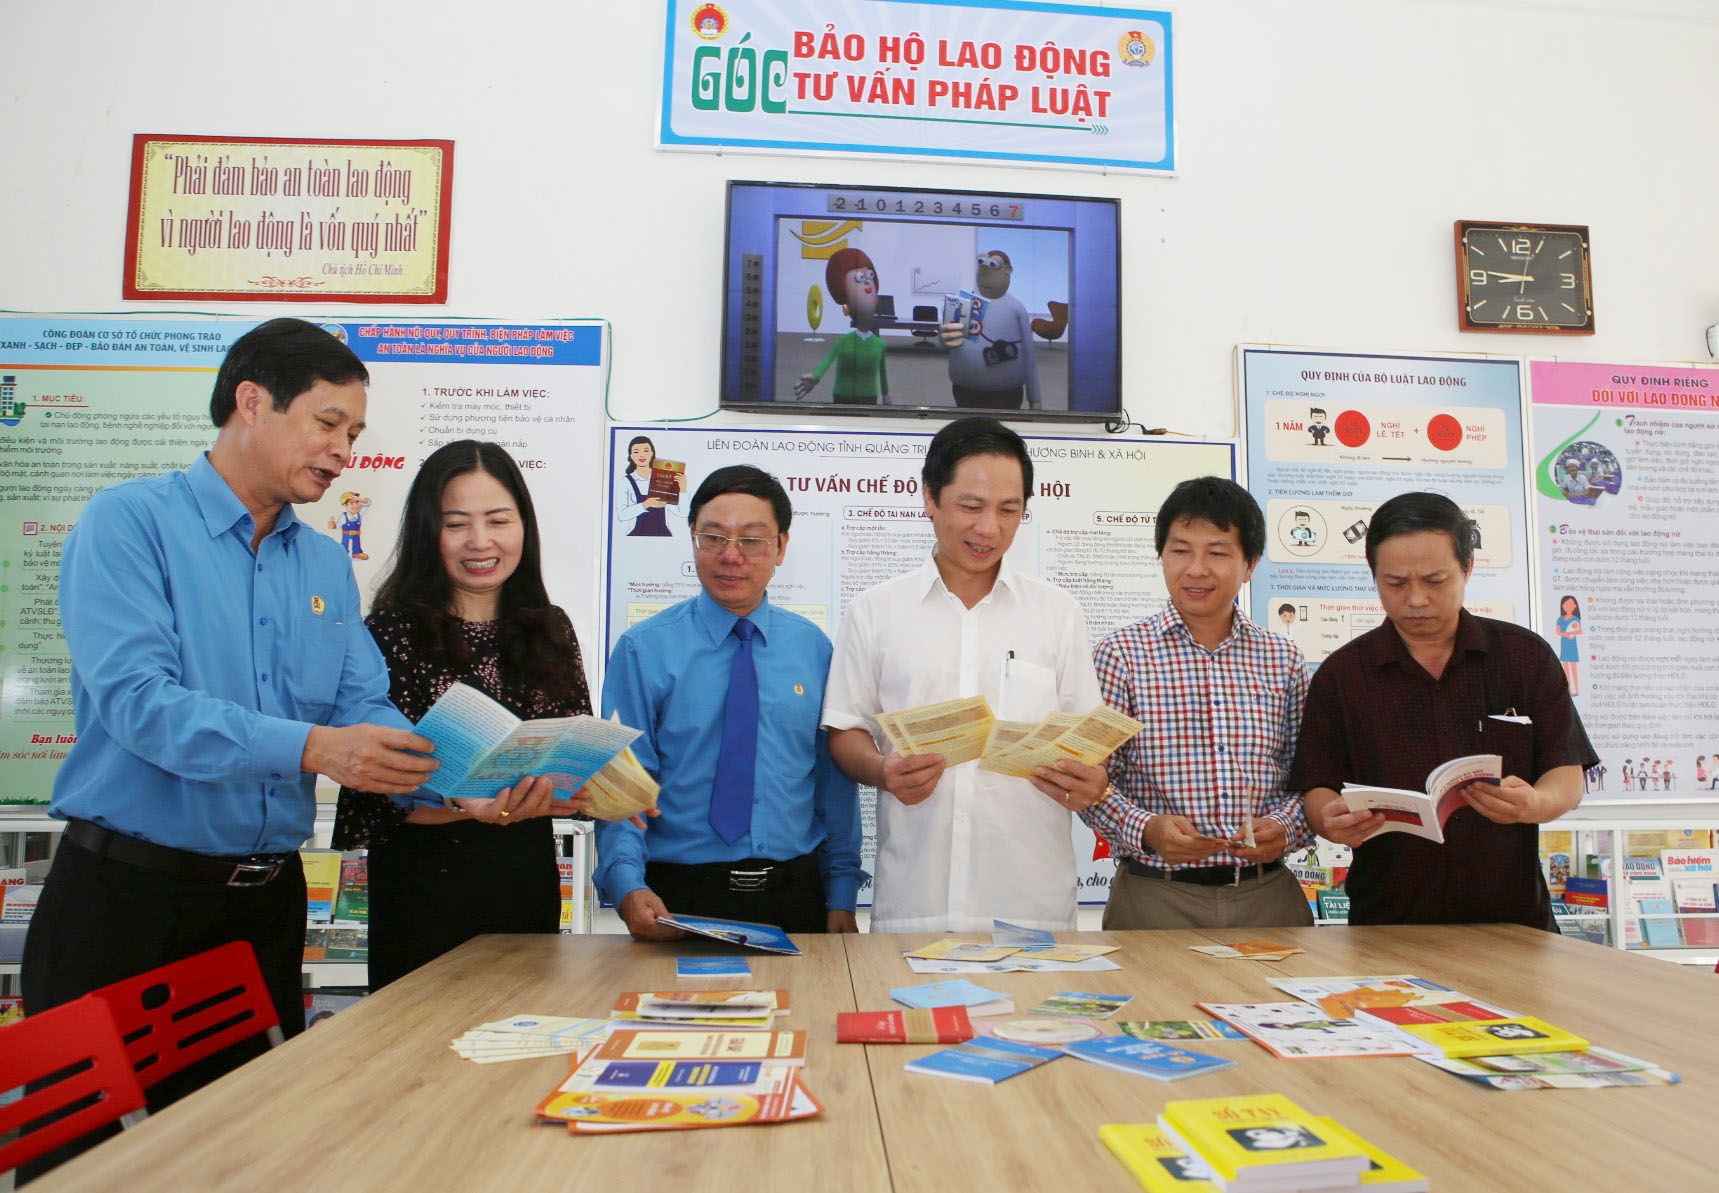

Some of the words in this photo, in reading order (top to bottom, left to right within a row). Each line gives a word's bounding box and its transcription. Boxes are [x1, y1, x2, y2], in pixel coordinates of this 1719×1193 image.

[793, 24, 864, 62] BẢO
[879, 33, 924, 71] HỘ
[939, 39, 1000, 70] LAO
[1014, 41, 1110, 78] ĐỘNG
[691, 32, 788, 115] GÓC
[793, 71, 838, 101] TƯ
[848, 65, 916, 105] VẤN
[929, 79, 1019, 111] PHÁP
[1031, 85, 1110, 123] LUẬT
[212, 155, 245, 196] đảm
[251, 156, 278, 196] bảo
[283, 166, 301, 196] an
[308, 159, 341, 197] toàn
[346, 160, 369, 198] lao
[374, 161, 411, 206] động
[877, 200, 886, 211] 0
[896, 200, 905, 212] 1
[914, 201, 924, 213] 2
[934, 203, 943, 214] 3
[952, 203, 961, 214] 4
[972, 204, 980, 216] 5
[990, 205, 1000, 216] 6
[1009, 206, 1018, 217] 7
[161, 209, 173, 248] vì
[178, 210, 223, 256] người
[228, 210, 250, 249] lao
[257, 211, 294, 257] động
[299, 210, 312, 250] là
[319, 207, 346, 251] vốn
[351, 213, 379, 259] quý
[1512, 239, 1531, 254] 12
[383, 265, 403, 276] Minh
[1470, 270, 1486, 285] 9
[1560, 273, 1575, 288] 3
[1517, 305, 1533, 320] 6
[43, 329, 67, 338] CÔNG
[359, 324, 381, 337] CHẤP
[383, 325, 406, 338] HÀNH
[408, 326, 423, 340] NỘI
[444, 328, 460, 340] QUY
[490, 327, 511, 342] BIỆN
[512, 328, 534, 340] PHÁP
[535, 328, 553, 340] LÀM
[555, 329, 574, 343] VIỆC
[377, 343, 390, 354] AN
[392, 341, 414, 354] TOÀN
[415, 342, 426, 354] LÀ
[427, 343, 453, 355] NGHĨA
[455, 344, 466, 357] VỤ
[486, 343, 513, 356] NGƯỜI
[513, 346, 529, 356] LAO
[1301, 370, 1321, 381] QUY
[1374, 372, 1387, 384] BỘ
[1418, 376, 1435, 385] LAO
[1439, 376, 1466, 388] ĐỘNG
[1612, 375, 1636, 385] QUY
[1675, 376, 1709, 388] RIÊNG
[434, 387, 472, 397] TRƯỚC
[476, 389, 493, 397] KHI
[497, 387, 519, 397] LÀM
[522, 390, 550, 399] VIỆC:
[1644, 393, 1666, 405] LAO
[1276, 422, 1280, 430] 1
[1284, 420, 1302, 431] NĂM
[707, 439, 729, 449] LIÊN
[733, 439, 768, 450] ĐOÀN
[772, 441, 795, 451] LAO
[798, 440, 835, 453] ĐỘNG
[839, 440, 861, 452] TỈNH
[865, 441, 909, 454] QUẢNG
[912, 445, 927, 456] TRỊ
[1029, 447, 1067, 459] HƯƠNG
[1070, 449, 1094, 459] BINH
[1098, 449, 1105, 458] &
[1109, 448, 1123, 459] XÃ
[1127, 448, 1146, 462] HỘI
[359, 454, 404, 472] ĐỘNG
[519, 460, 546, 470] VIỆC:
[787, 477, 811, 491] TƯ
[816, 474, 850, 492] VẤN
[857, 475, 889, 493] CHẾ
[893, 477, 917, 496] ĐỘ
[1040, 480, 1070, 500] HỘI
[857, 508, 871, 517] CHẾ
[874, 509, 885, 518] ĐỘ
[1107, 513, 1123, 523] CHẾ
[1126, 514, 1138, 526] ĐỘ
[1086, 872, 1107, 887] cho
